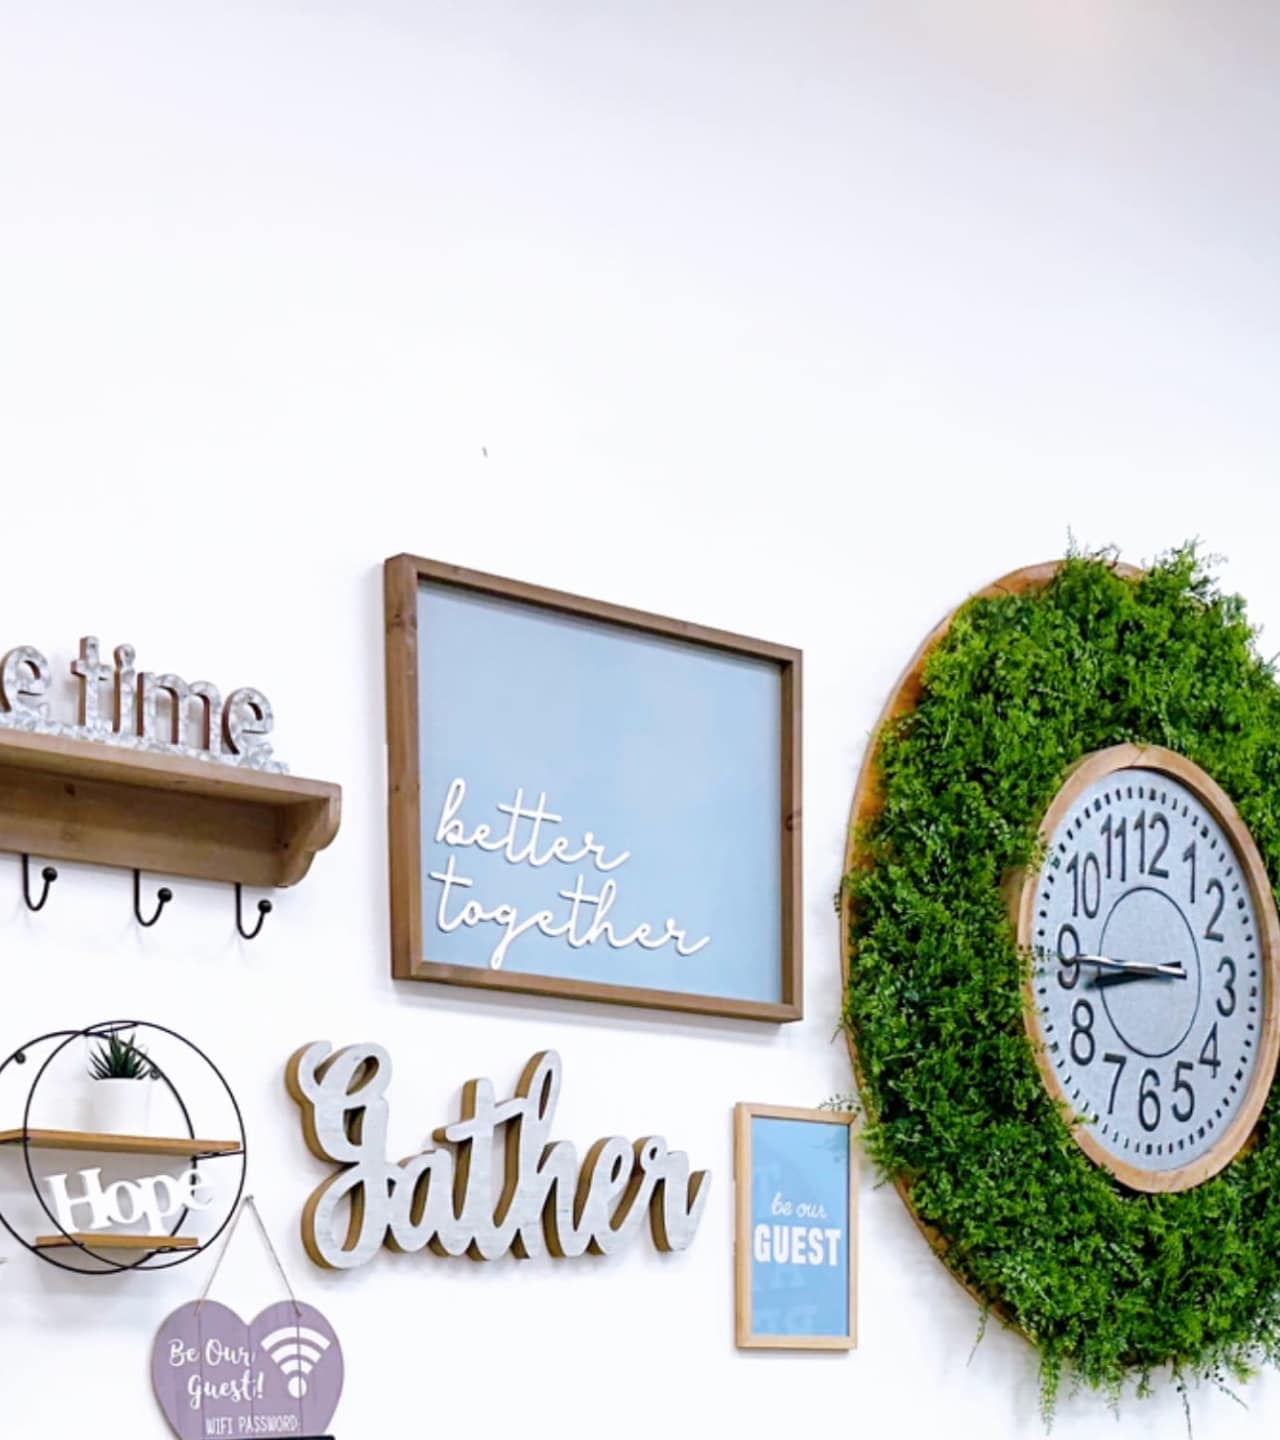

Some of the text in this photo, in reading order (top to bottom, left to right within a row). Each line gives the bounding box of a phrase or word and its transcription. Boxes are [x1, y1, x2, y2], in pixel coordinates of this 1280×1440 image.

[72, 635, 275, 757] time
[434, 777, 631, 872] better
[1101, 813, 1127, 882] 11
[1135, 811, 1171, 879] 12
[1065, 851, 1101, 919] 10
[1182, 839, 1198, 903] 1
[428, 852, 710, 970] together
[1204, 878, 1225, 942] 2
[1057, 923, 1081, 990] 9
[1216, 955, 1237, 1018] 3
[1070, 998, 1096, 1067] 8
[1199, 1021, 1221, 1079] 4
[1102, 1053, 1127, 1115] 7
[1138, 1068, 1162, 1132] 6
[1171, 1061, 1195, 1123] 5
[284, 1040, 712, 1270] Gather
[43, 1167, 213, 1237] Hope
[770, 1191, 827, 1220] be our
[753, 1223, 842, 1267] GUEST
[168, 1338, 256, 1367] Be Our
[187, 1369, 265, 1410] Guest!
[205, 1414, 298, 1435] WIFI PASSWORD
